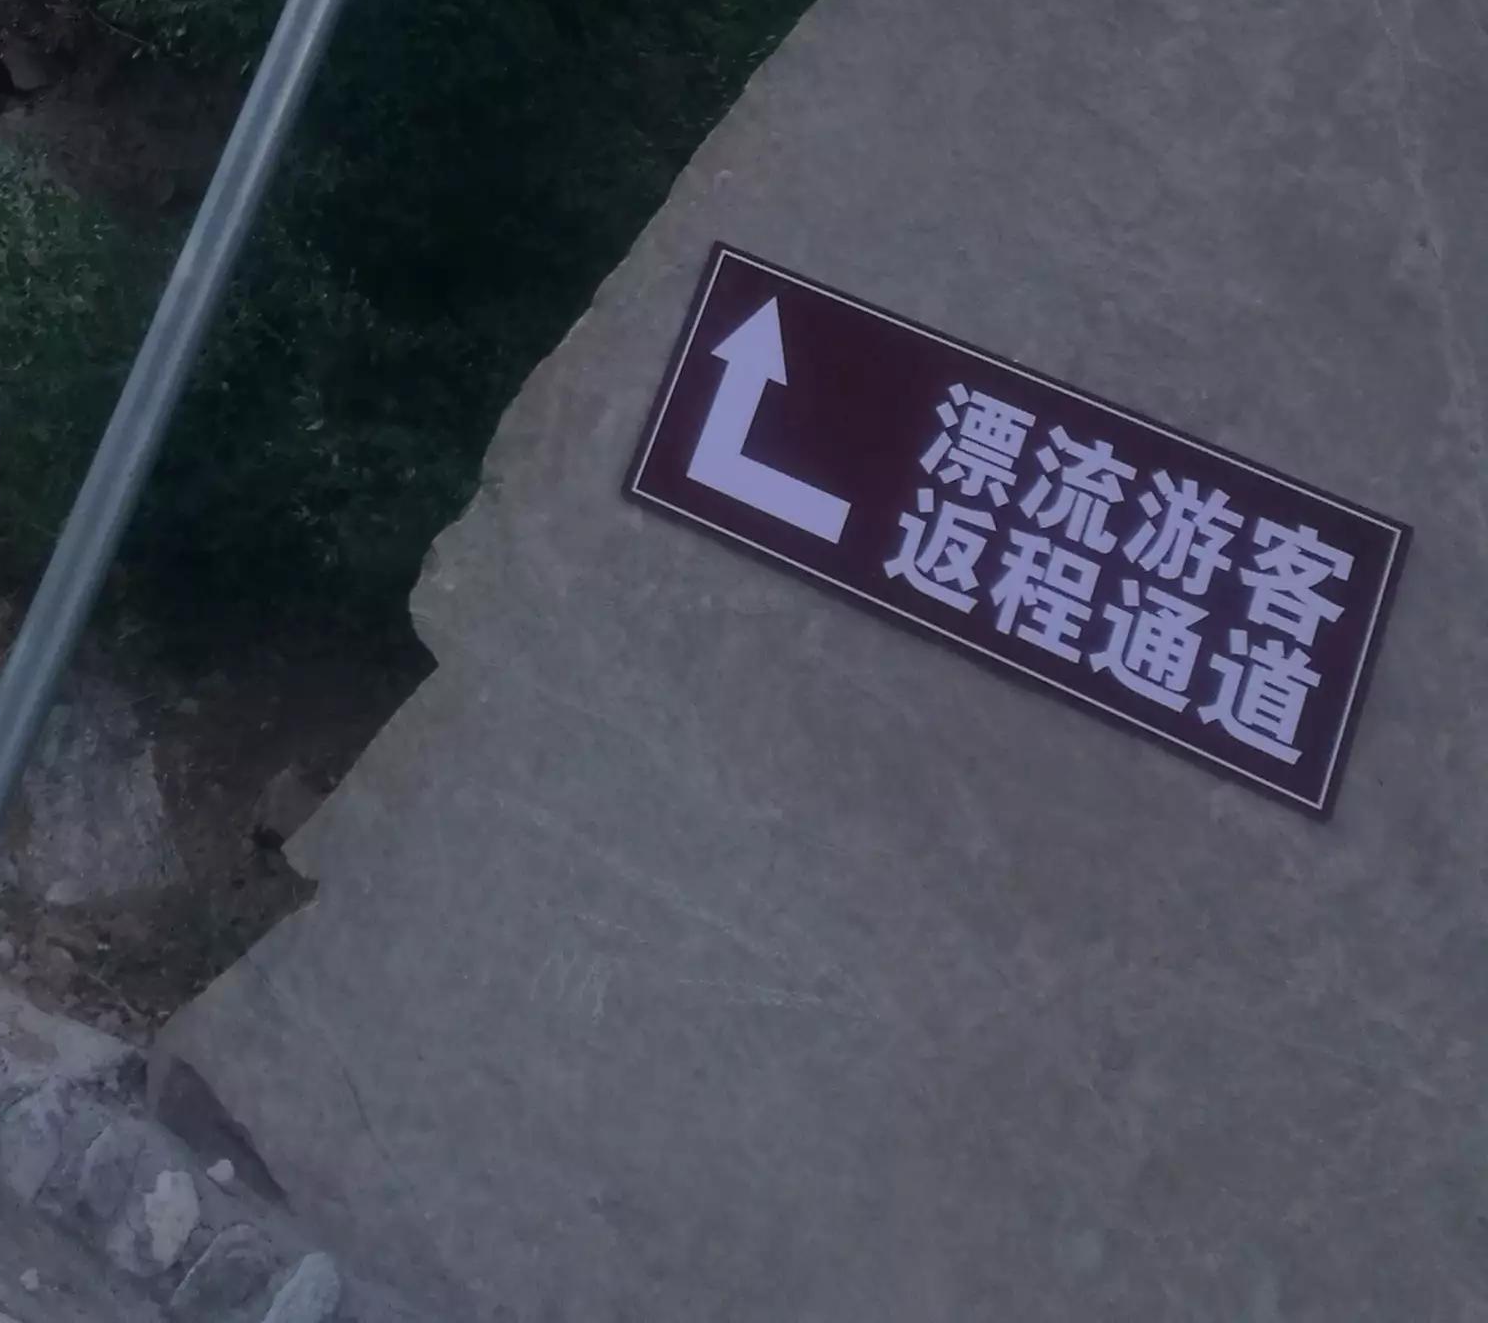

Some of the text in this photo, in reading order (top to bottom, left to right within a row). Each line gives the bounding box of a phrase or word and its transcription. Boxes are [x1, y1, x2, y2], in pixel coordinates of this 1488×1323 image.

[884, 487, 1321, 765] 返程通道
[919, 382, 1354, 646] 漂流游客
